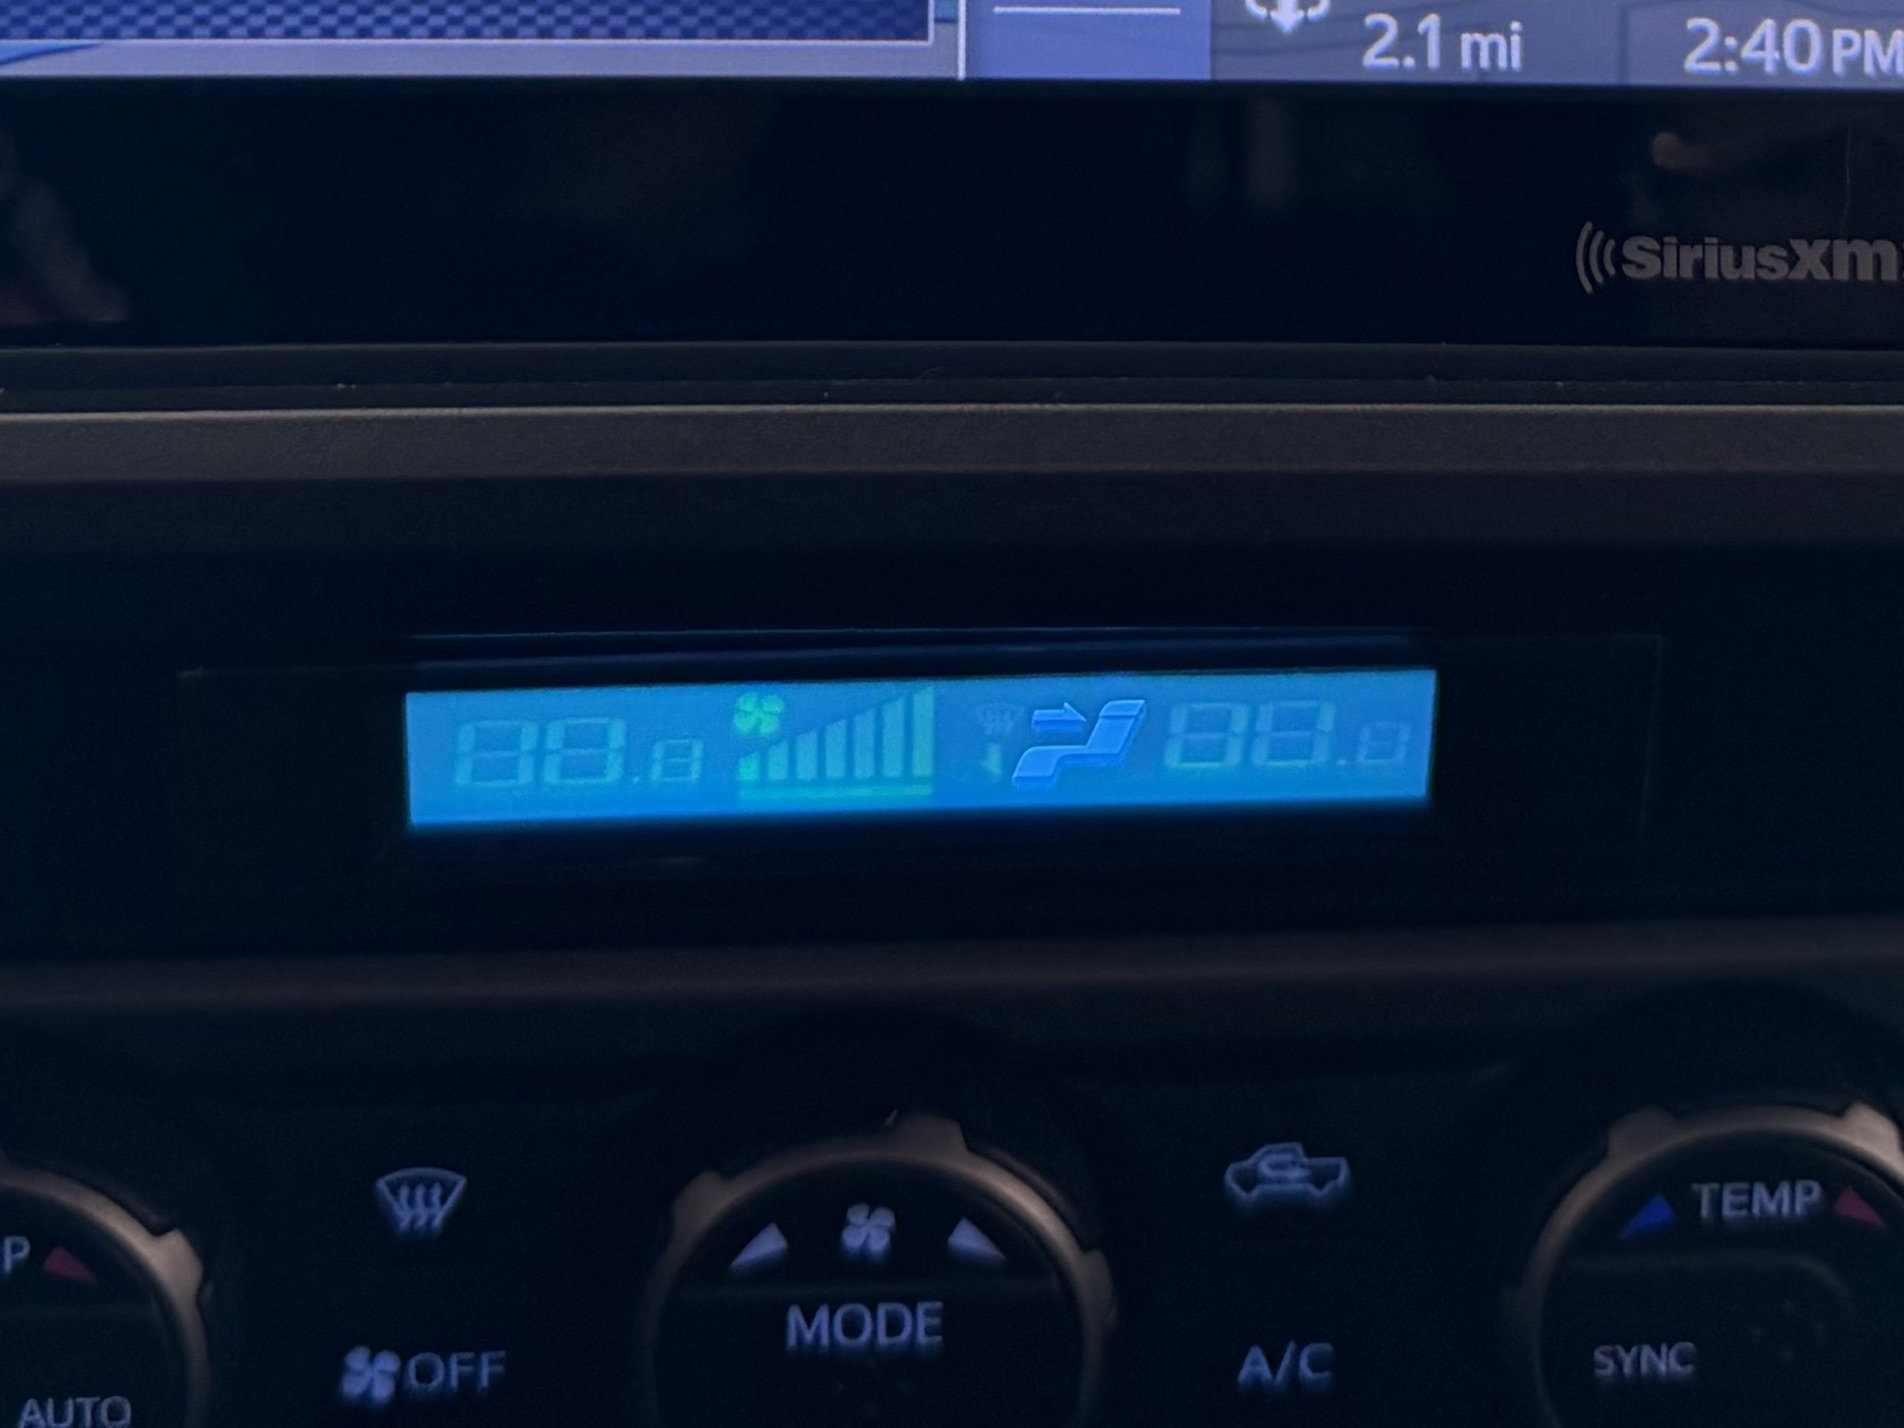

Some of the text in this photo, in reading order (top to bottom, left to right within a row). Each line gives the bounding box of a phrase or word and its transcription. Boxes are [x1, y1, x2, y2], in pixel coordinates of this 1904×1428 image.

[1362, 13, 1523, 72] 2.1 mi
[1694, 1181, 1823, 1222] TEMP
[787, 1301, 944, 1351] MODE
[407, 1351, 506, 1391] OFF
[1238, 1343, 1333, 1389] A/C
[1592, 1344, 1695, 1378] SYNC
[18, 1395, 132, 1428] AUTO
